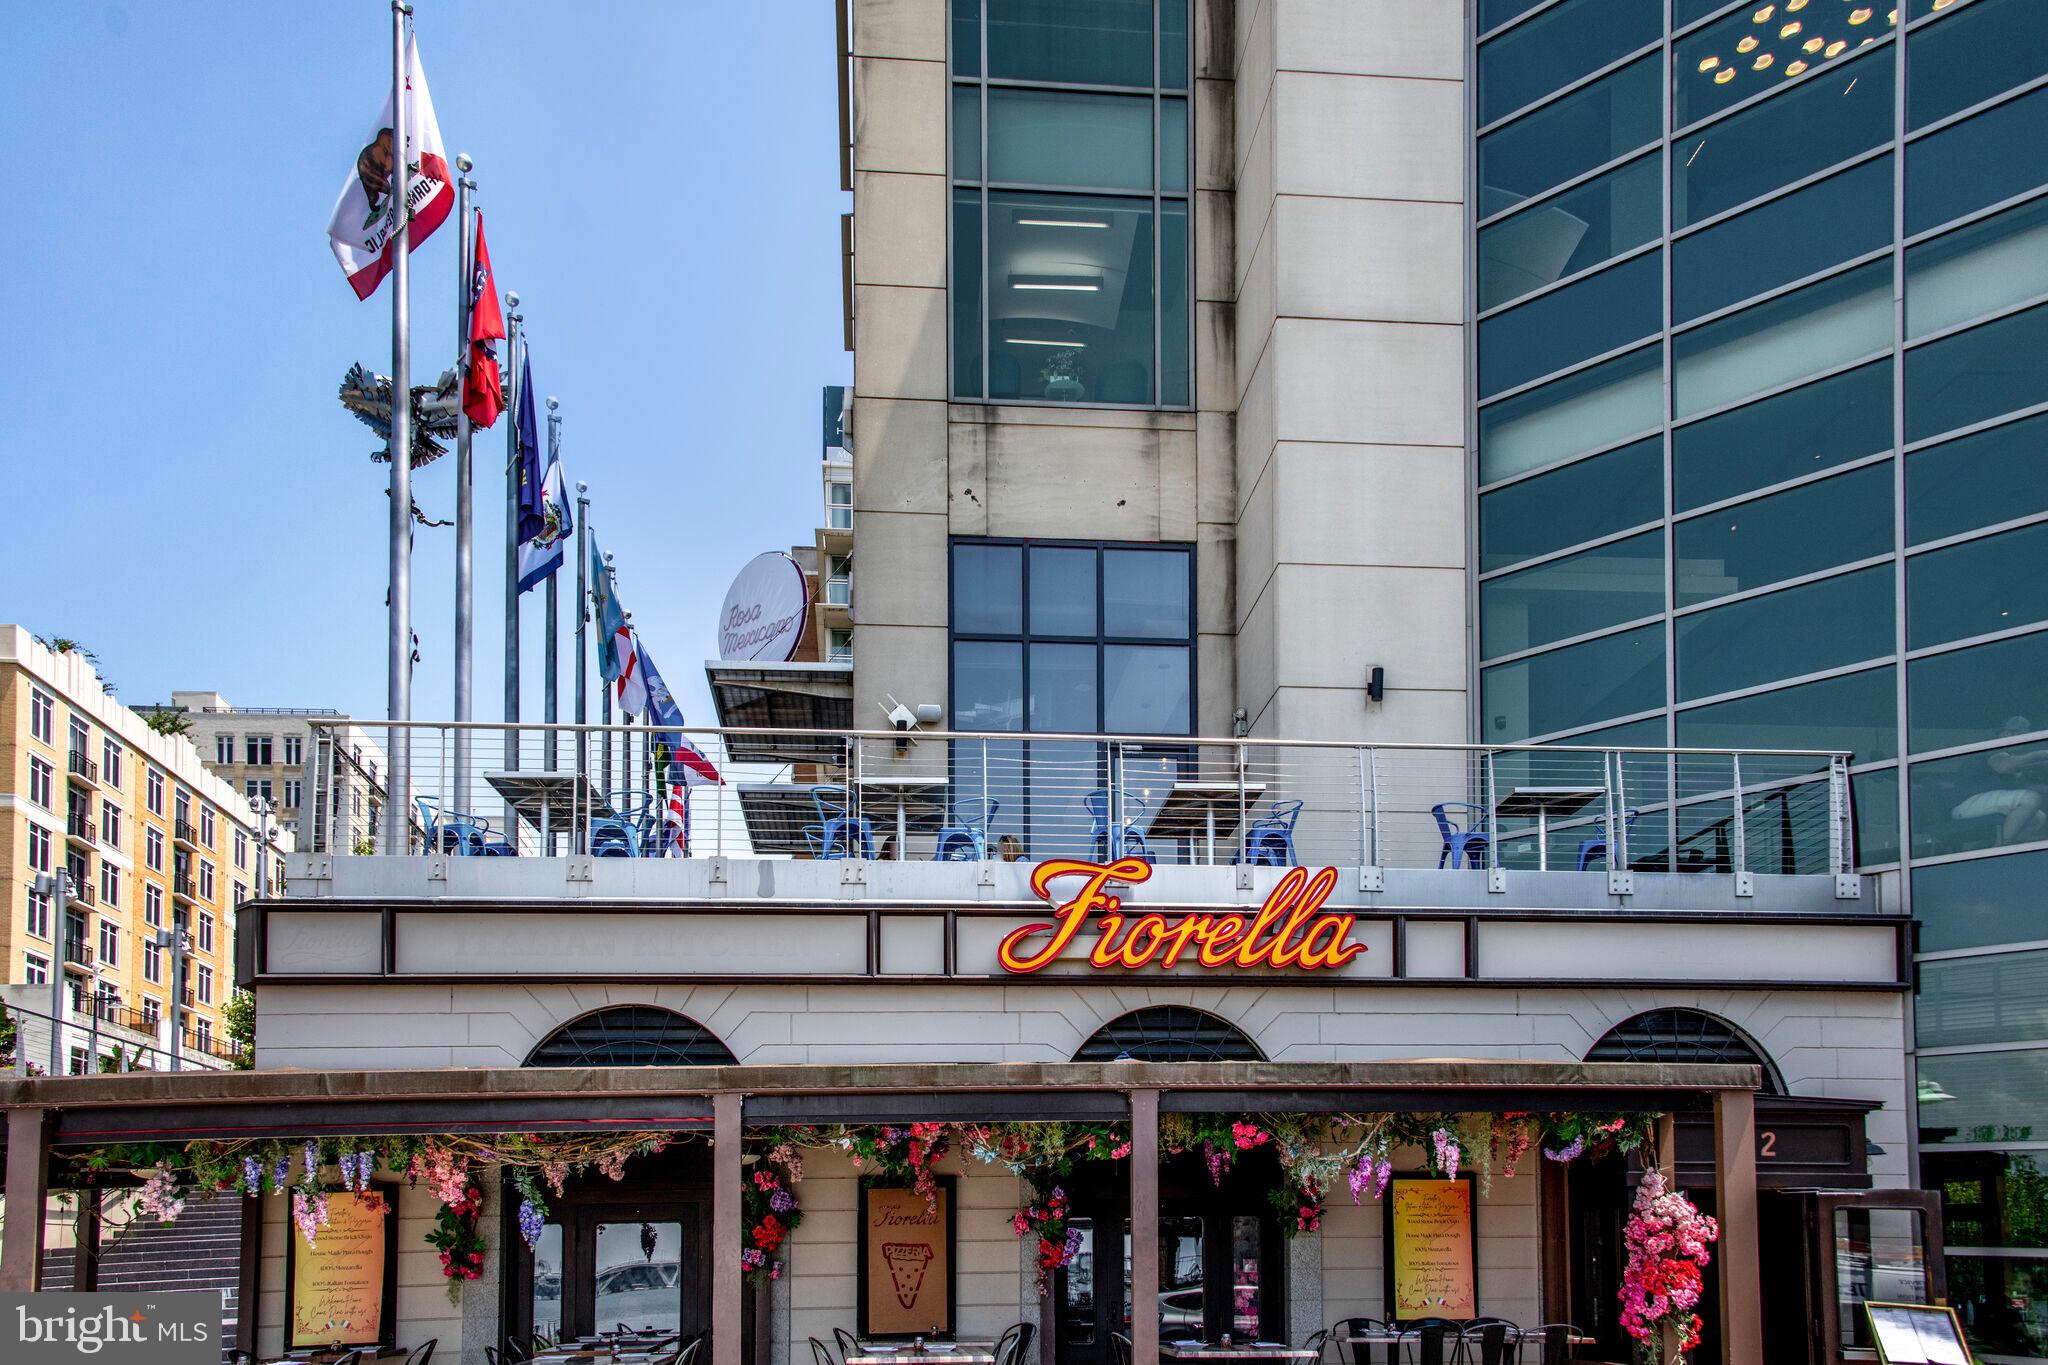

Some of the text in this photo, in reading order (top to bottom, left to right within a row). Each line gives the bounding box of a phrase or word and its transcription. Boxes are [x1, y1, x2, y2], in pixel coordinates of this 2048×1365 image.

[723, 604, 762, 632] Rosa
[723, 616, 794, 655] Mexicano
[997, 856, 1369, 974] Fiorella
[1760, 1131, 1777, 1157] 2
[885, 1246, 931, 1257] PIZZERIA
